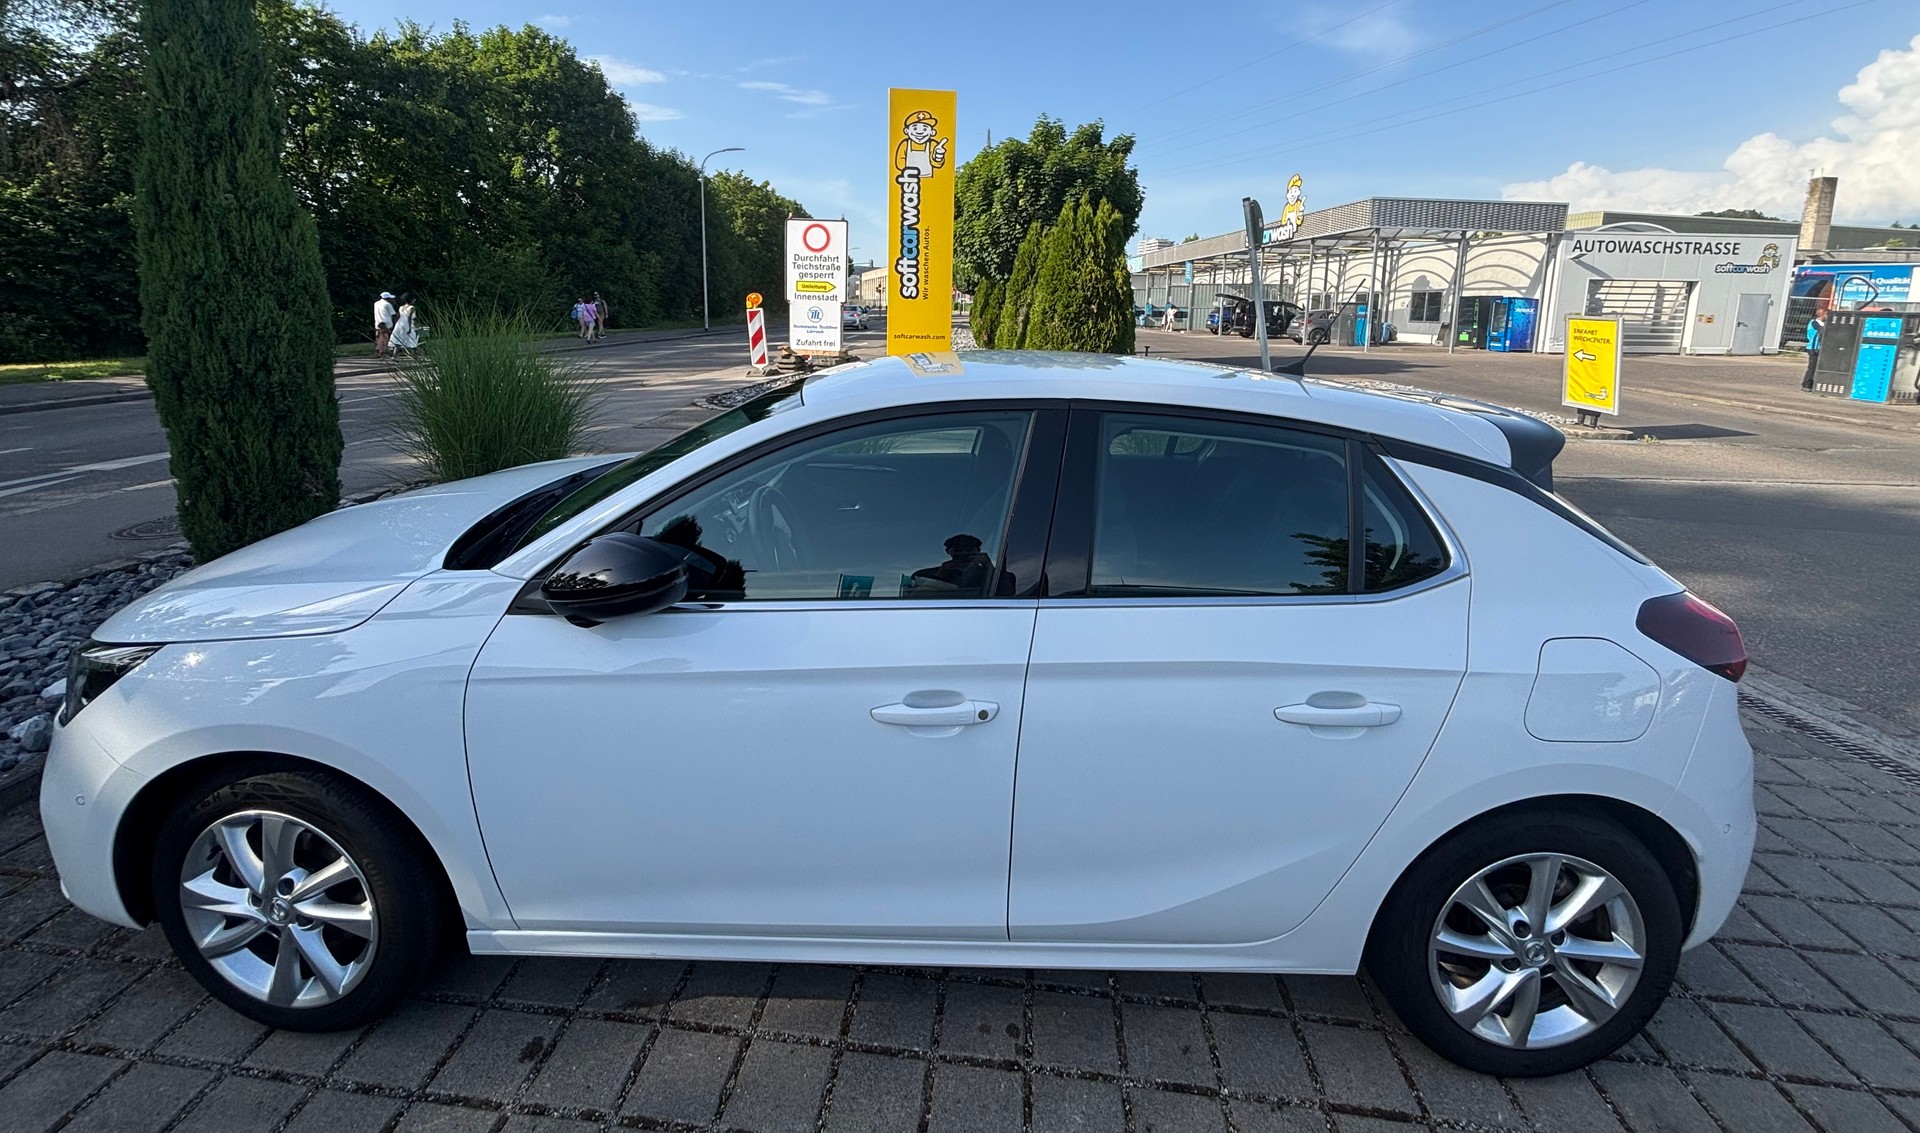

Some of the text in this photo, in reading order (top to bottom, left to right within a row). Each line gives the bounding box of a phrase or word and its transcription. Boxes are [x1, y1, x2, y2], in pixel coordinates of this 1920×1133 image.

[897, 168, 920, 298] softcarwash
[1572, 240, 1741, 255] AUTOWASCHSTRASSE
[794, 254, 840, 262] Durchfahrt
[792, 262, 841, 271] Teichstraße
[1716, 262, 1770, 273] softcarwash
[794, 292, 838, 302] Innenstadt
